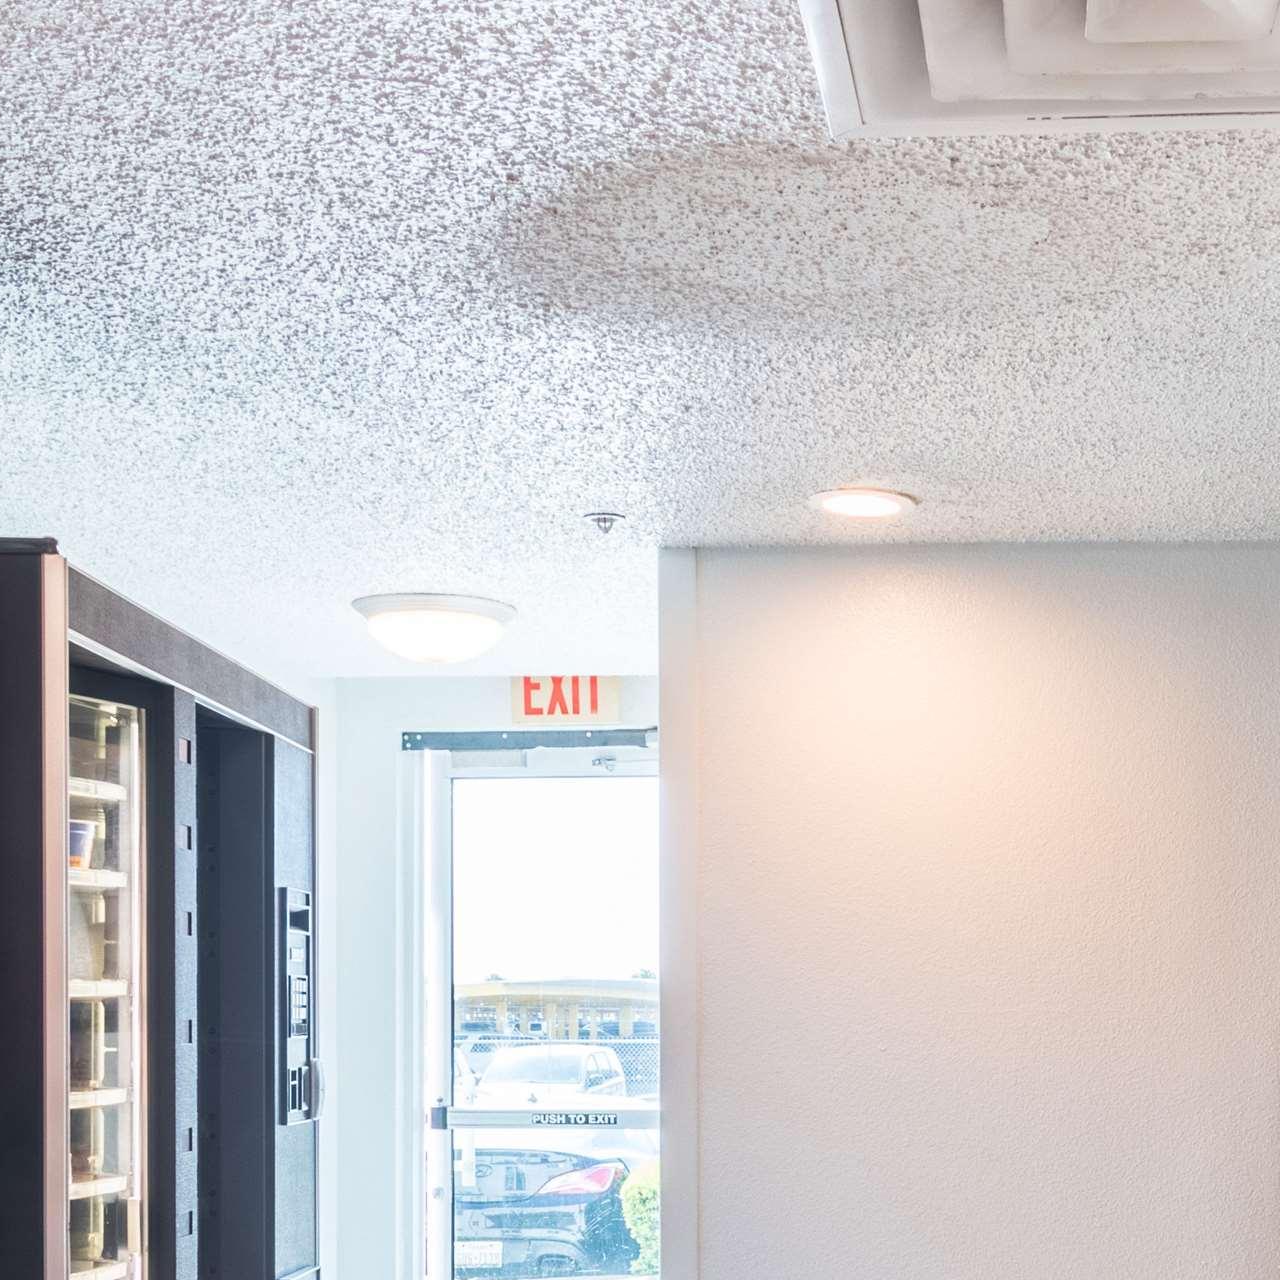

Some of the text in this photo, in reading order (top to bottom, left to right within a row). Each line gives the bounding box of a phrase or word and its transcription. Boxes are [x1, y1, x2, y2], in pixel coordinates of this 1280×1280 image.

[523, 676, 598, 715] EXIT
[533, 1113, 617, 1125] PUSH TO EXIT
